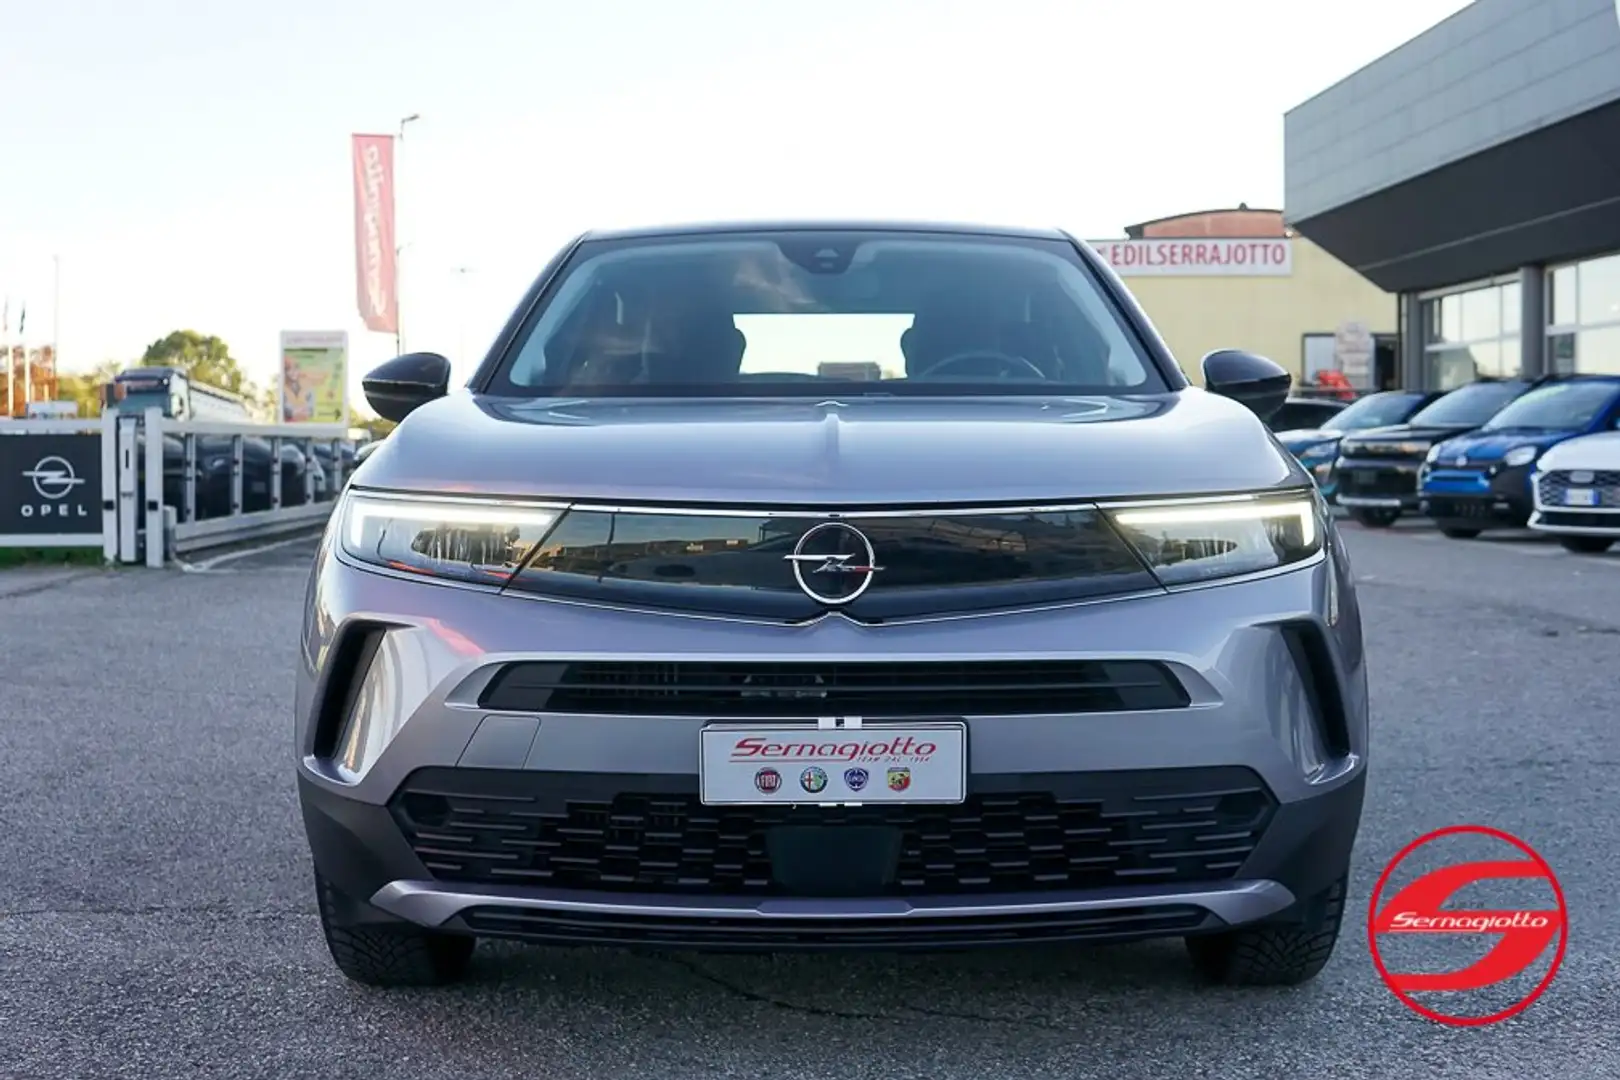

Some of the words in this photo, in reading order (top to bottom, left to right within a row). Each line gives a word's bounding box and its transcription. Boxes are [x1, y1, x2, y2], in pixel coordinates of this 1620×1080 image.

[1111, 243, 1286, 265] EDILSERRAJOTTO
[21, 503, 88, 518] OPEL
[730, 736, 937, 761] Sernagiotto
